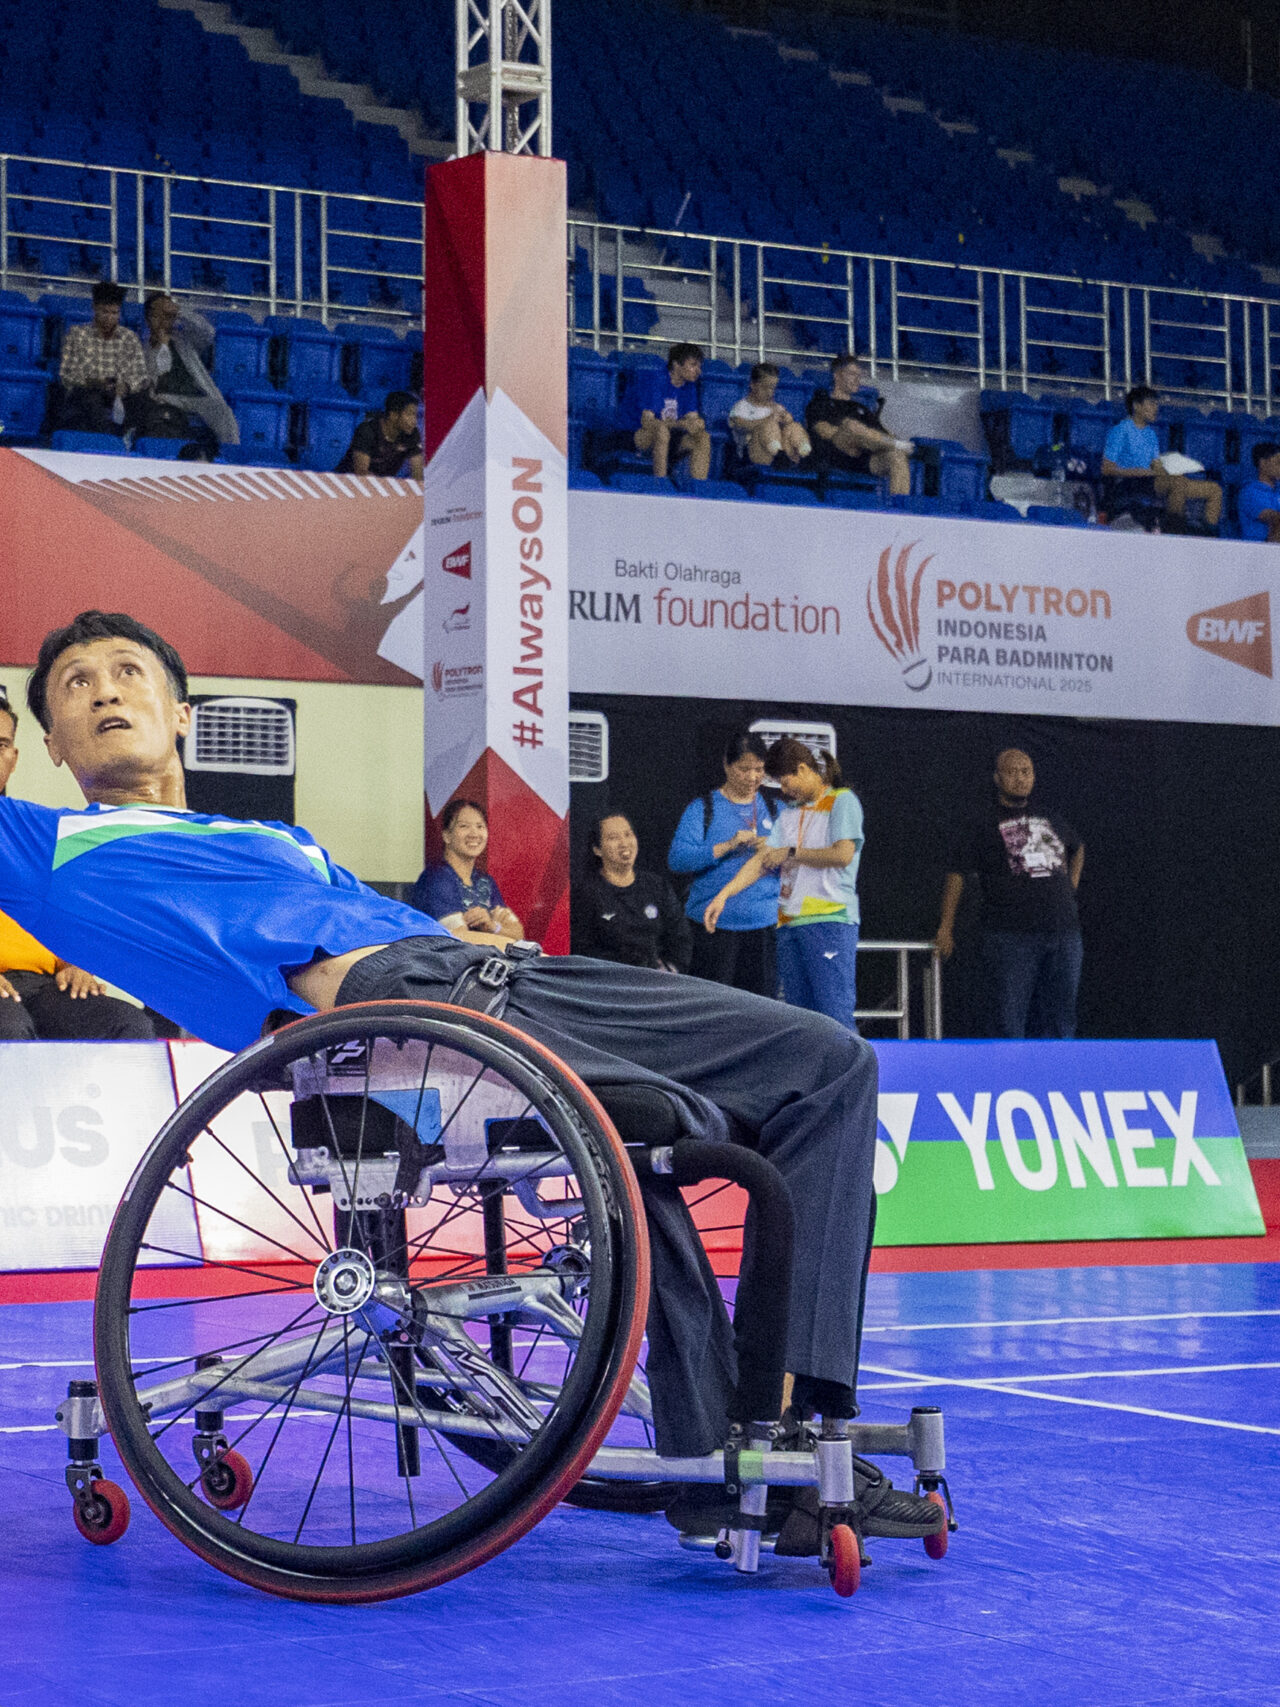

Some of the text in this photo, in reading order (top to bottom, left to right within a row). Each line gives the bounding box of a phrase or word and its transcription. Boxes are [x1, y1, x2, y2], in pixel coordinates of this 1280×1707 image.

[615, 559, 741, 588] Bakti Olahraga
[511, 456, 552, 750] #AlwaysON
[653, 587, 841, 635] foundation
[937, 579, 1112, 619] POLYTRON
[937, 619, 1047, 642] INDONESIA
[1197, 618, 1265, 645] BWF
[937, 645, 1113, 672] PARA BADMINTON
[937, 671, 1093, 693] INTERNATIONAL 2025
[936, 1088, 1222, 1192] YONEX
